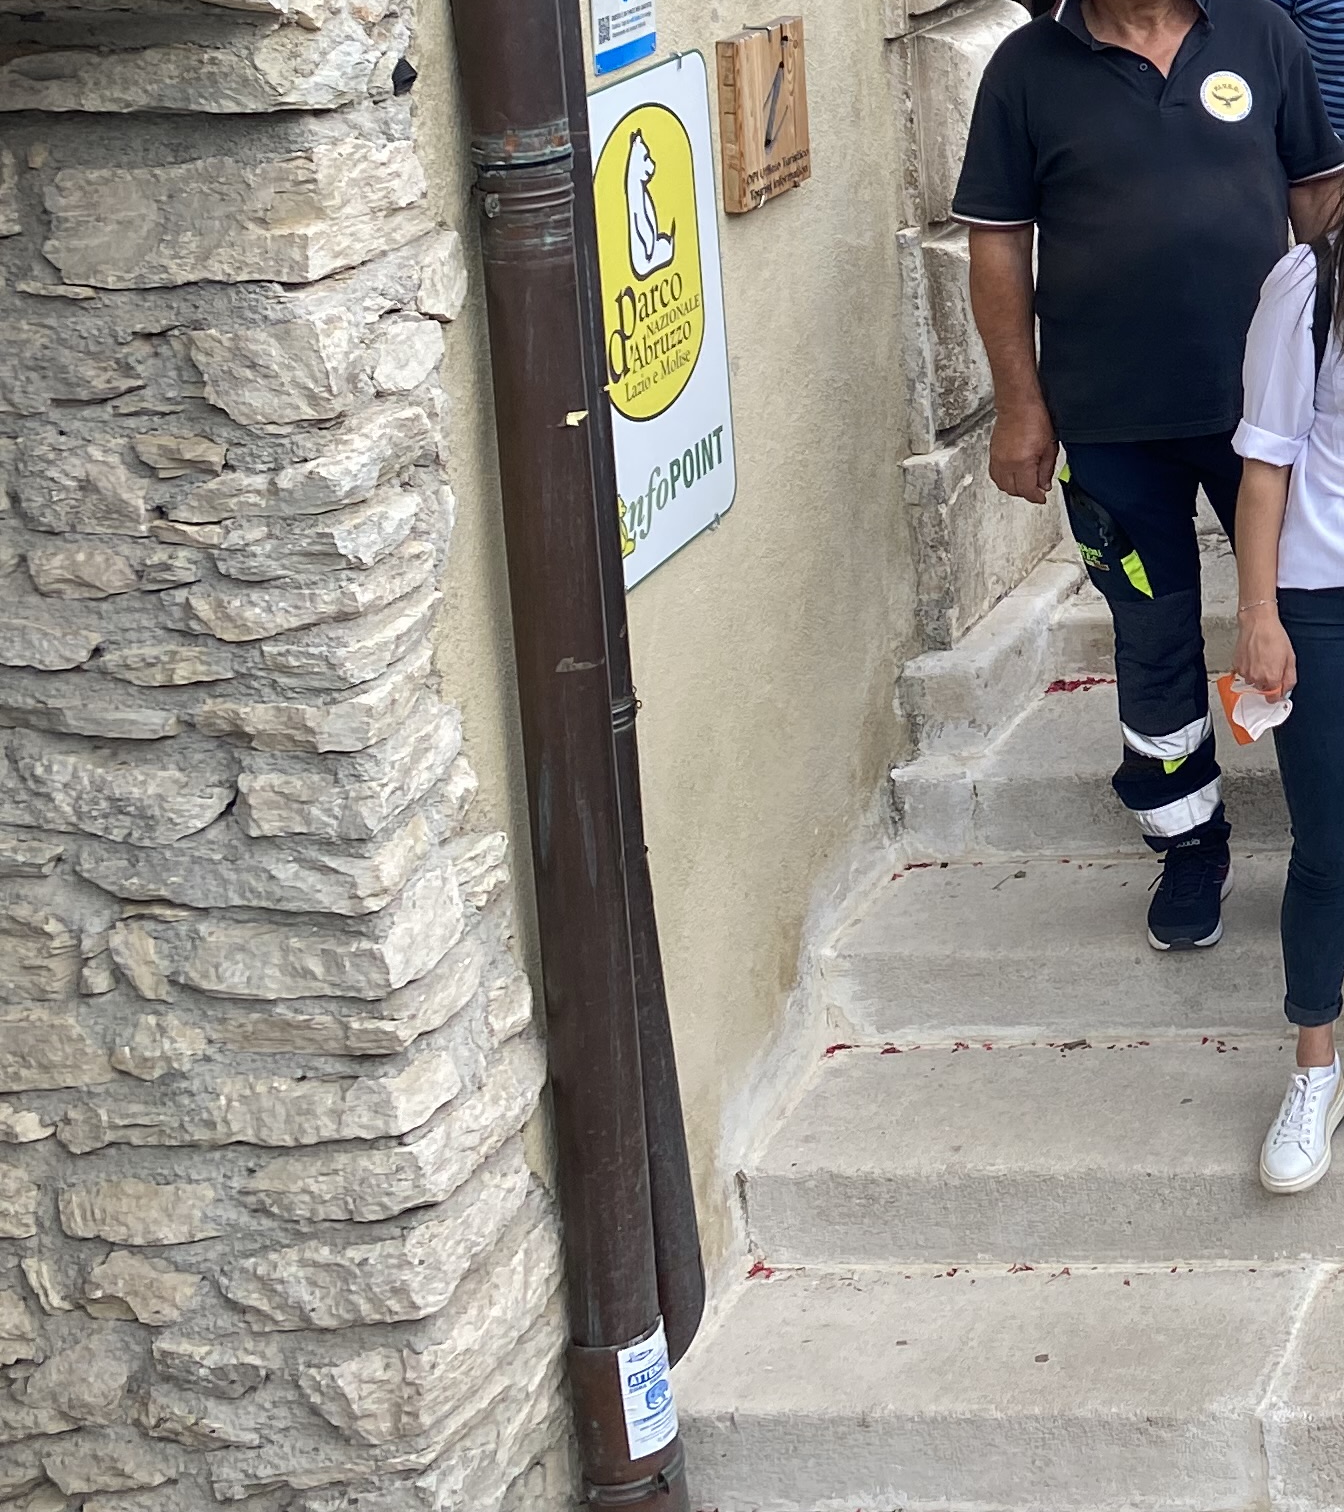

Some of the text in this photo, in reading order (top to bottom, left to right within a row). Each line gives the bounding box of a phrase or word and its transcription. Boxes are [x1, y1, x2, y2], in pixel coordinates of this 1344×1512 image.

[615, 273, 682, 340] Parco
[646, 293, 701, 338] NAZIONALE
[609, 320, 692, 384] d'Abruzzo
[624, 349, 691, 403] Lazio e Molise
